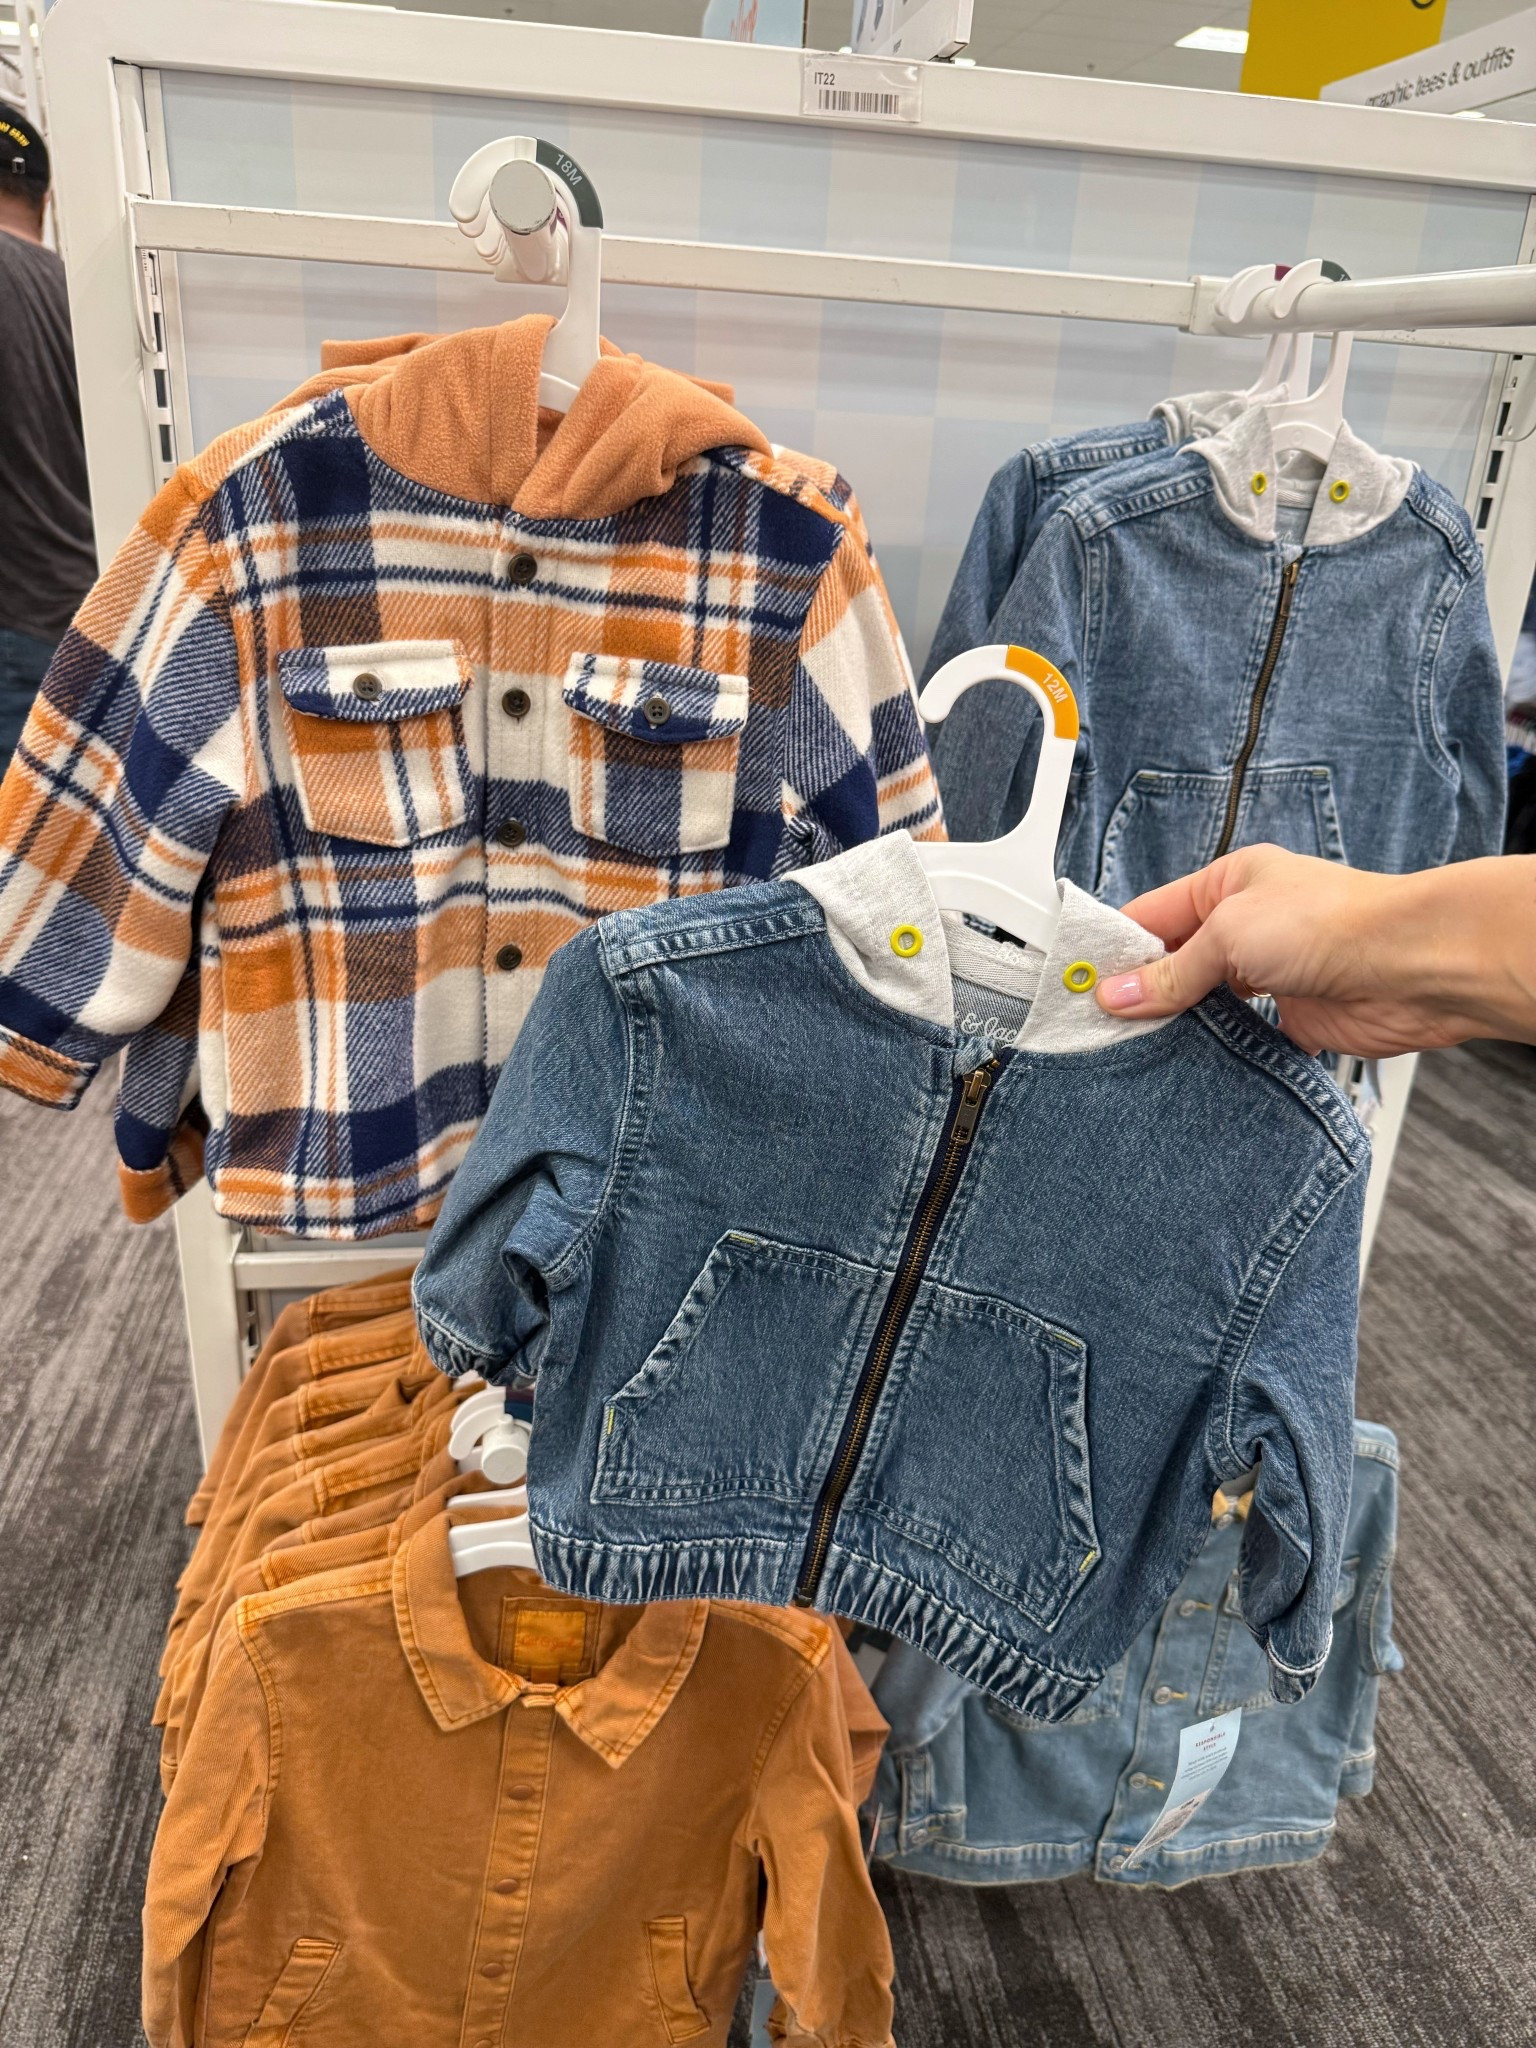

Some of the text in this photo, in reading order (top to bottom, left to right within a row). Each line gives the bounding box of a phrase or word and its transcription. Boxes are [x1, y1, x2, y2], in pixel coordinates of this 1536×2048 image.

[814, 71, 836, 87] IT22
[1415, 71, 1447, 98] tees
[1449, 61, 1461, 87] &
[1463, 46, 1515, 82] outfits
[556, 153, 583, 186] 18M
[1042, 672, 1069, 703] 12M
[961, 1012, 983, 1034] &
